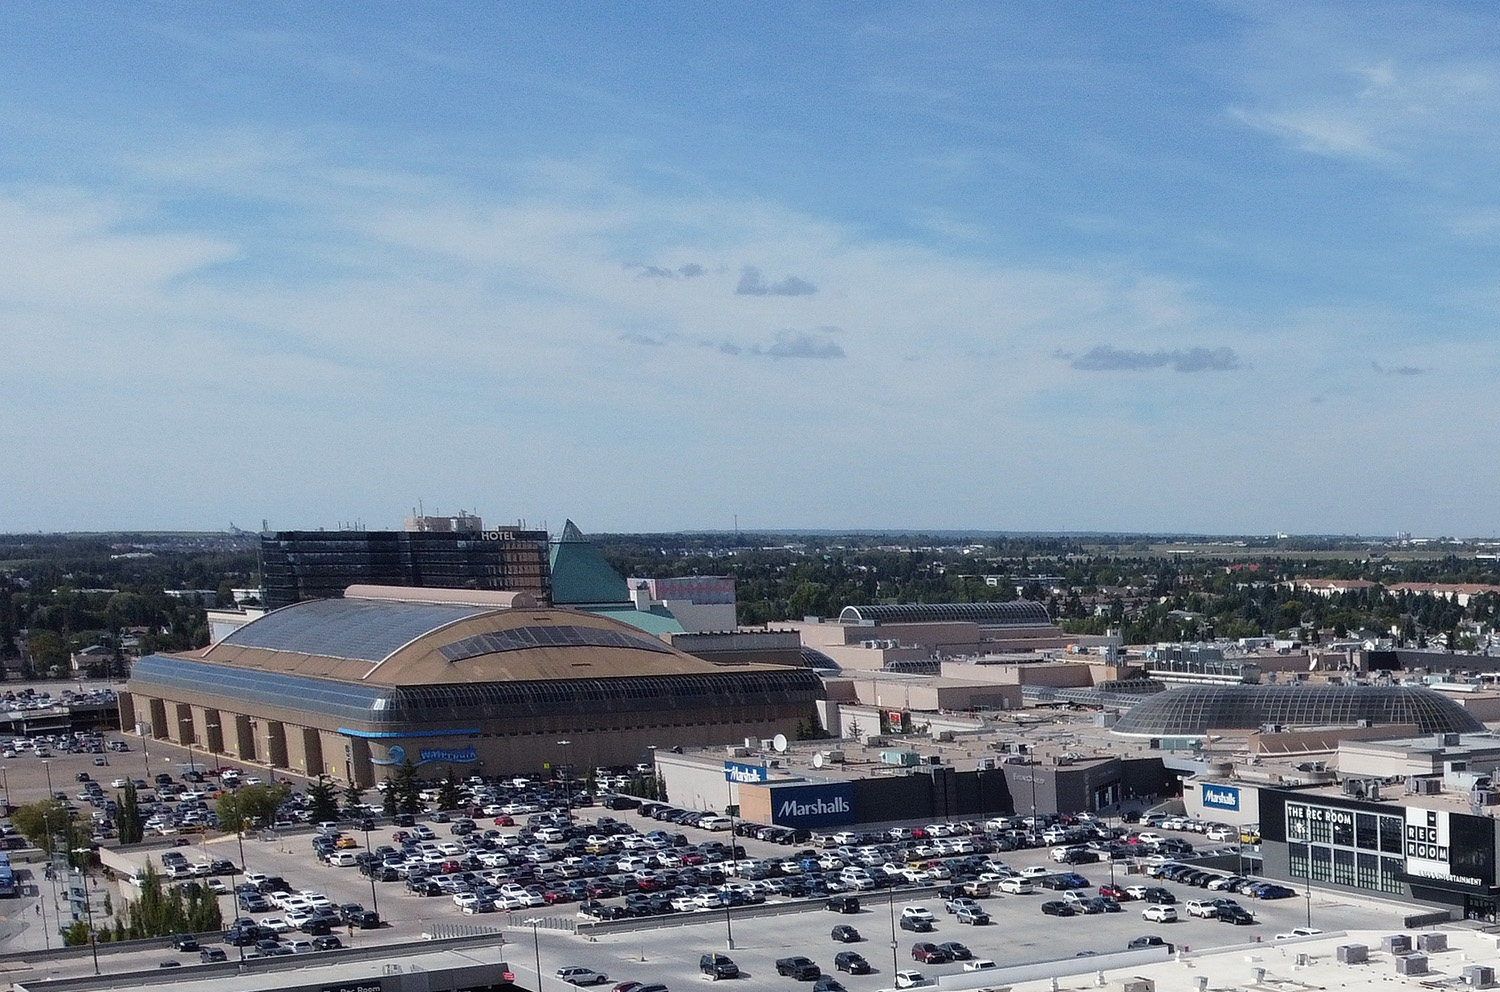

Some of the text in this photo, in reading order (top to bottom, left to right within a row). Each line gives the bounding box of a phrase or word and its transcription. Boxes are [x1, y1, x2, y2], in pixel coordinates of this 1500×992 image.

[481, 532, 515, 540] HOTEL
[1204, 790, 1236, 806] Marshalls
[778, 797, 850, 818] Marshalls
[1288, 806, 1351, 825] THE REC ROOM
[1408, 827, 1436, 841] REC
[1408, 843, 1447, 860] ROOM
